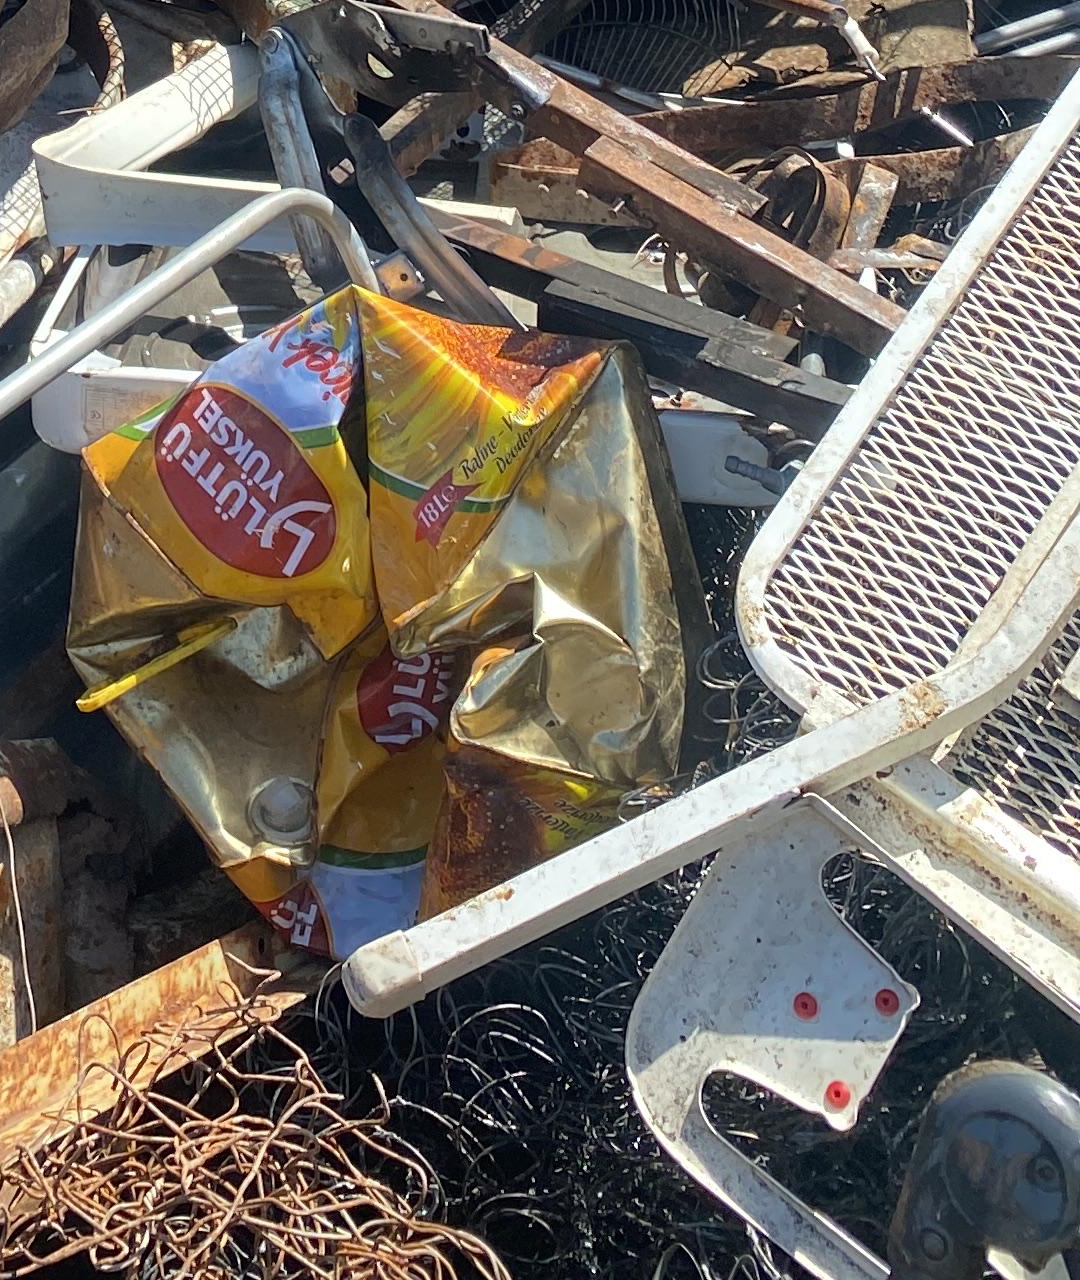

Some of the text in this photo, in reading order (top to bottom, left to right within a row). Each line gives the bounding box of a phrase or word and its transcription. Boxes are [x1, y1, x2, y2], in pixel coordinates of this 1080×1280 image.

[162, 421, 268, 537] LÜTFÜ
[192, 388, 285, 503] YÜKSEL
[457, 434, 499, 481] Rafine
